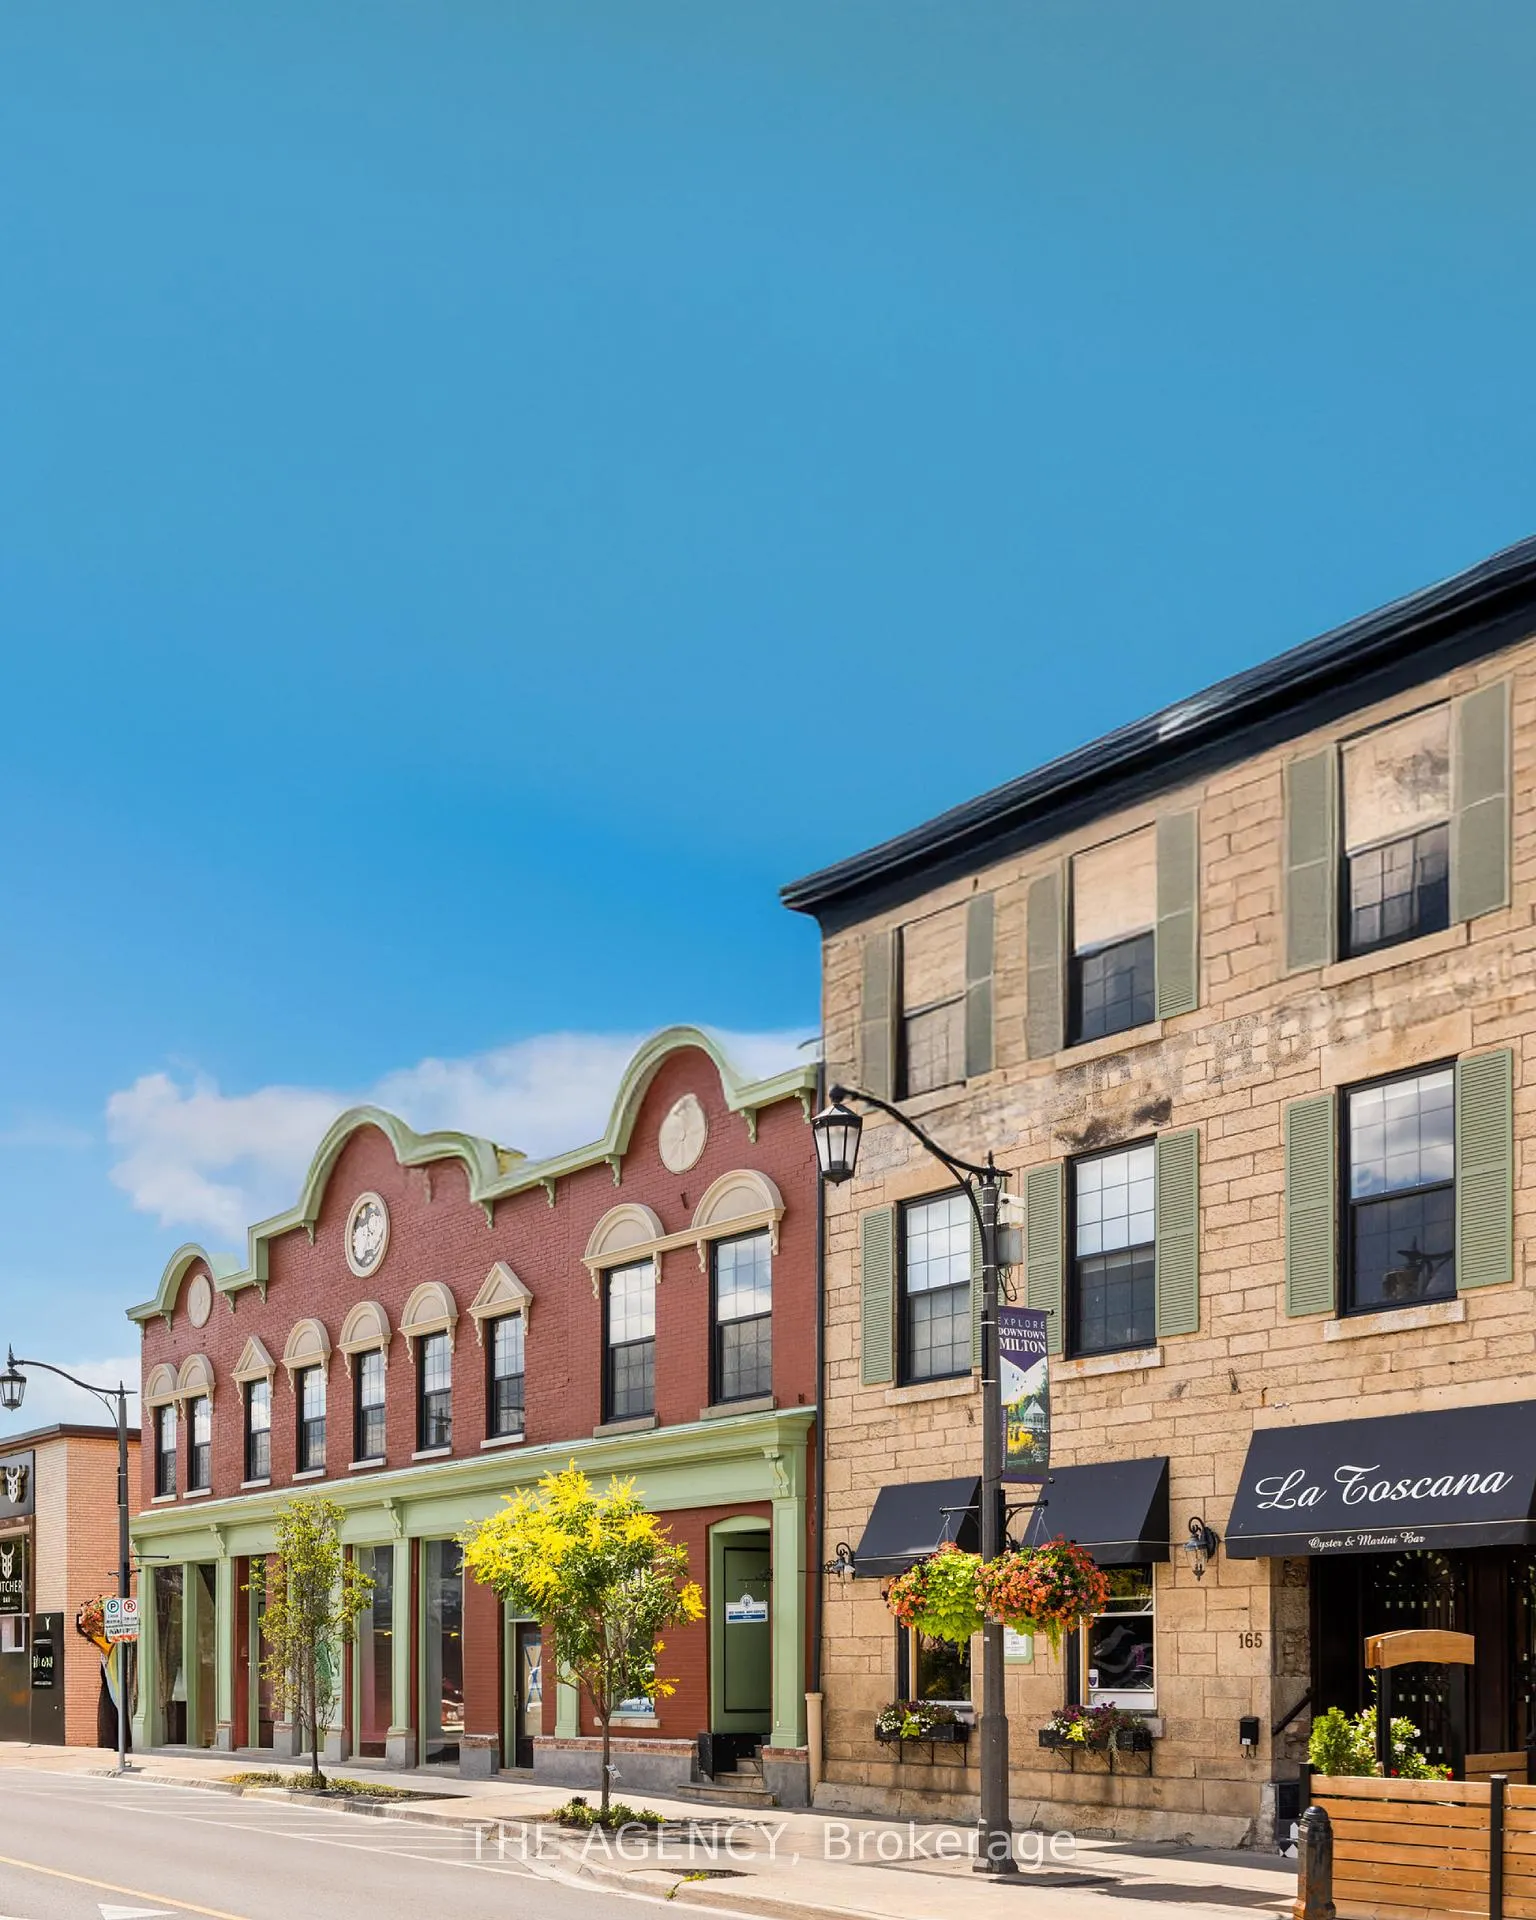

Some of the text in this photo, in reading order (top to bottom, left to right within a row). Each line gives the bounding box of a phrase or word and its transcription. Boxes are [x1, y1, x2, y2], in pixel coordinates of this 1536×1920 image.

[998, 1317, 1045, 1330] EXPLORE
[998, 1327, 1046, 1340] DOWNTOWN
[1000, 1337, 1047, 1353] MILTON
[1255, 1464, 1514, 1510] La Toscana
[1308, 1531, 1426, 1551] Oyster & Martini Bar
[1239, 1632, 1262, 1649] 165
